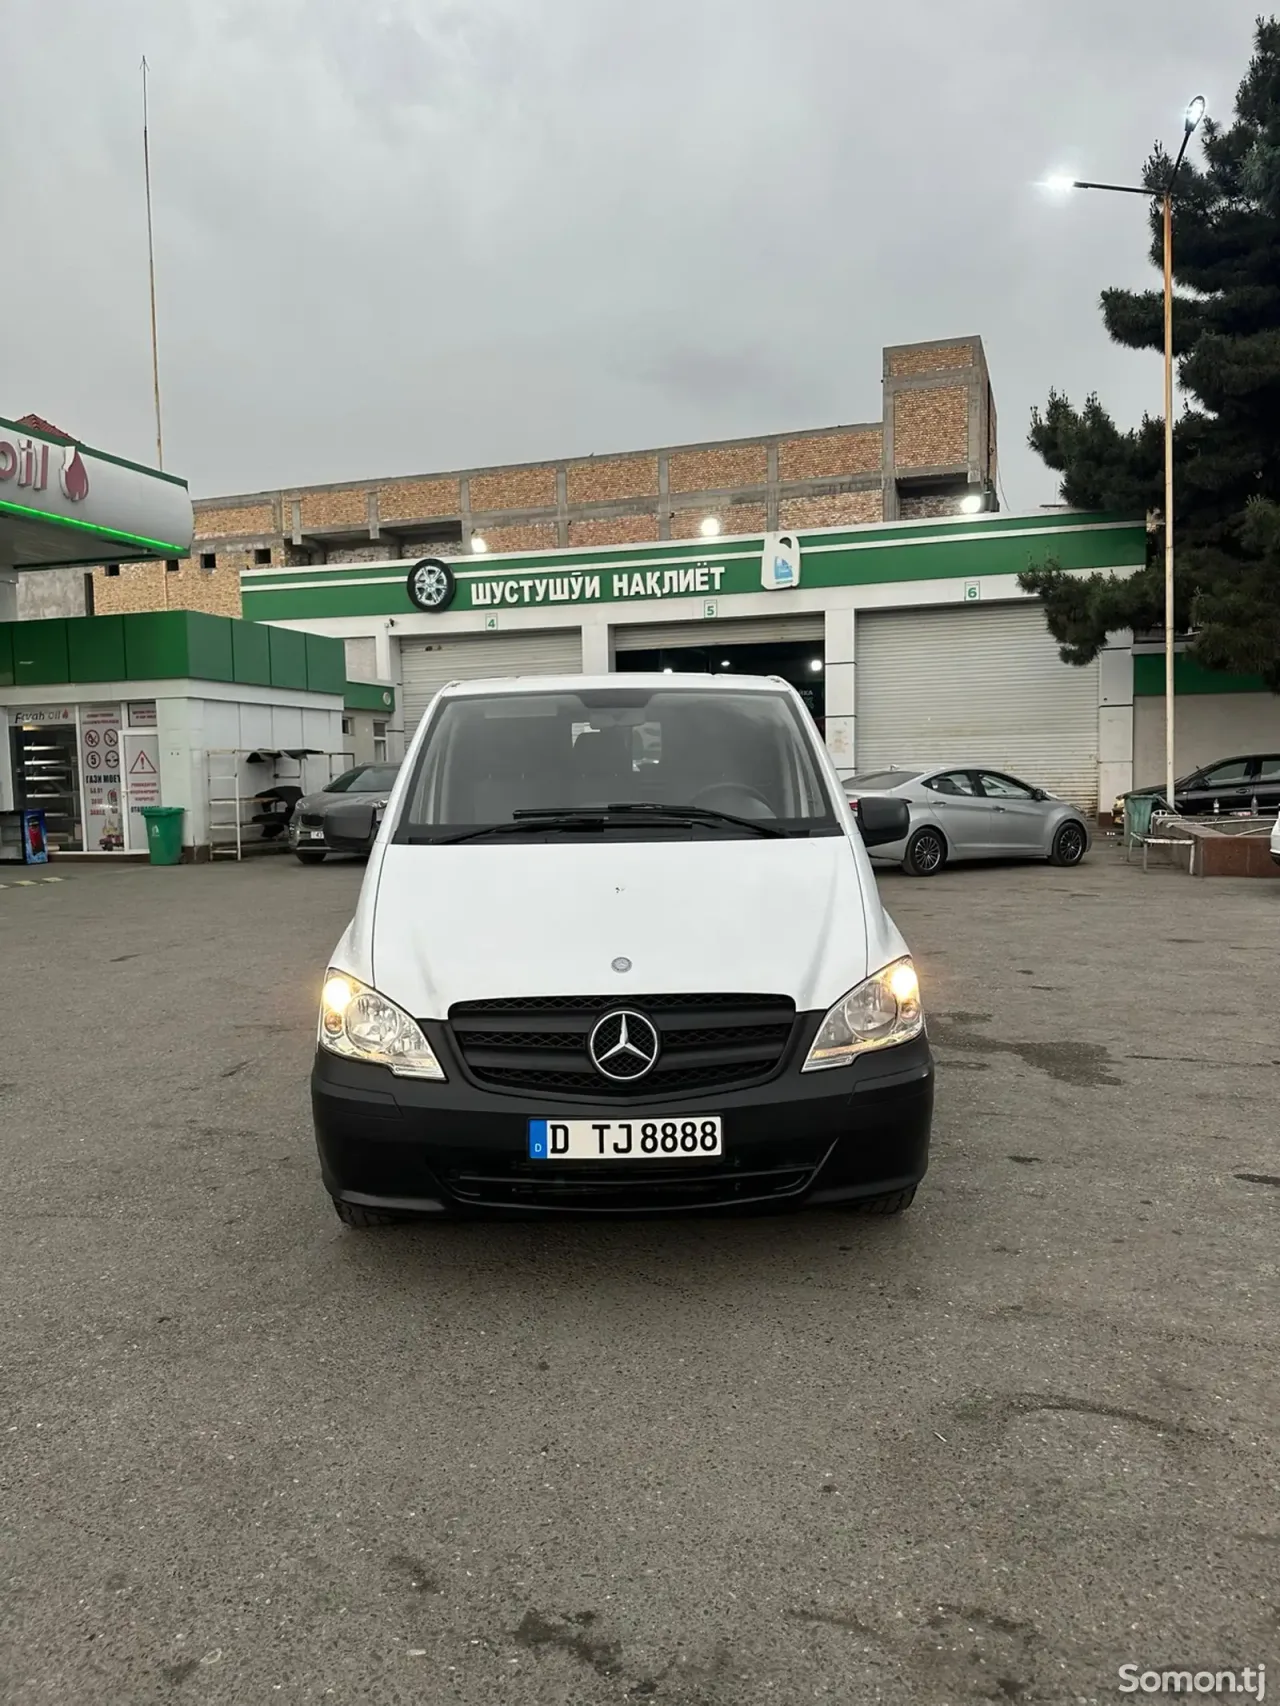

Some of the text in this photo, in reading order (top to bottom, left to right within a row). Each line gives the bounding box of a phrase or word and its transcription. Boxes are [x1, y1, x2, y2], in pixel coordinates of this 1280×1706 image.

[612, 562, 725, 597] НАҚЛИЁТ
[967, 587, 977, 598] 6
[706, 605, 715, 615] 5
[487, 618, 495, 628] 4
[90, 754, 97, 765] 5
[550, 1124, 569, 1154] D
[534, 1143, 542, 1152] D
